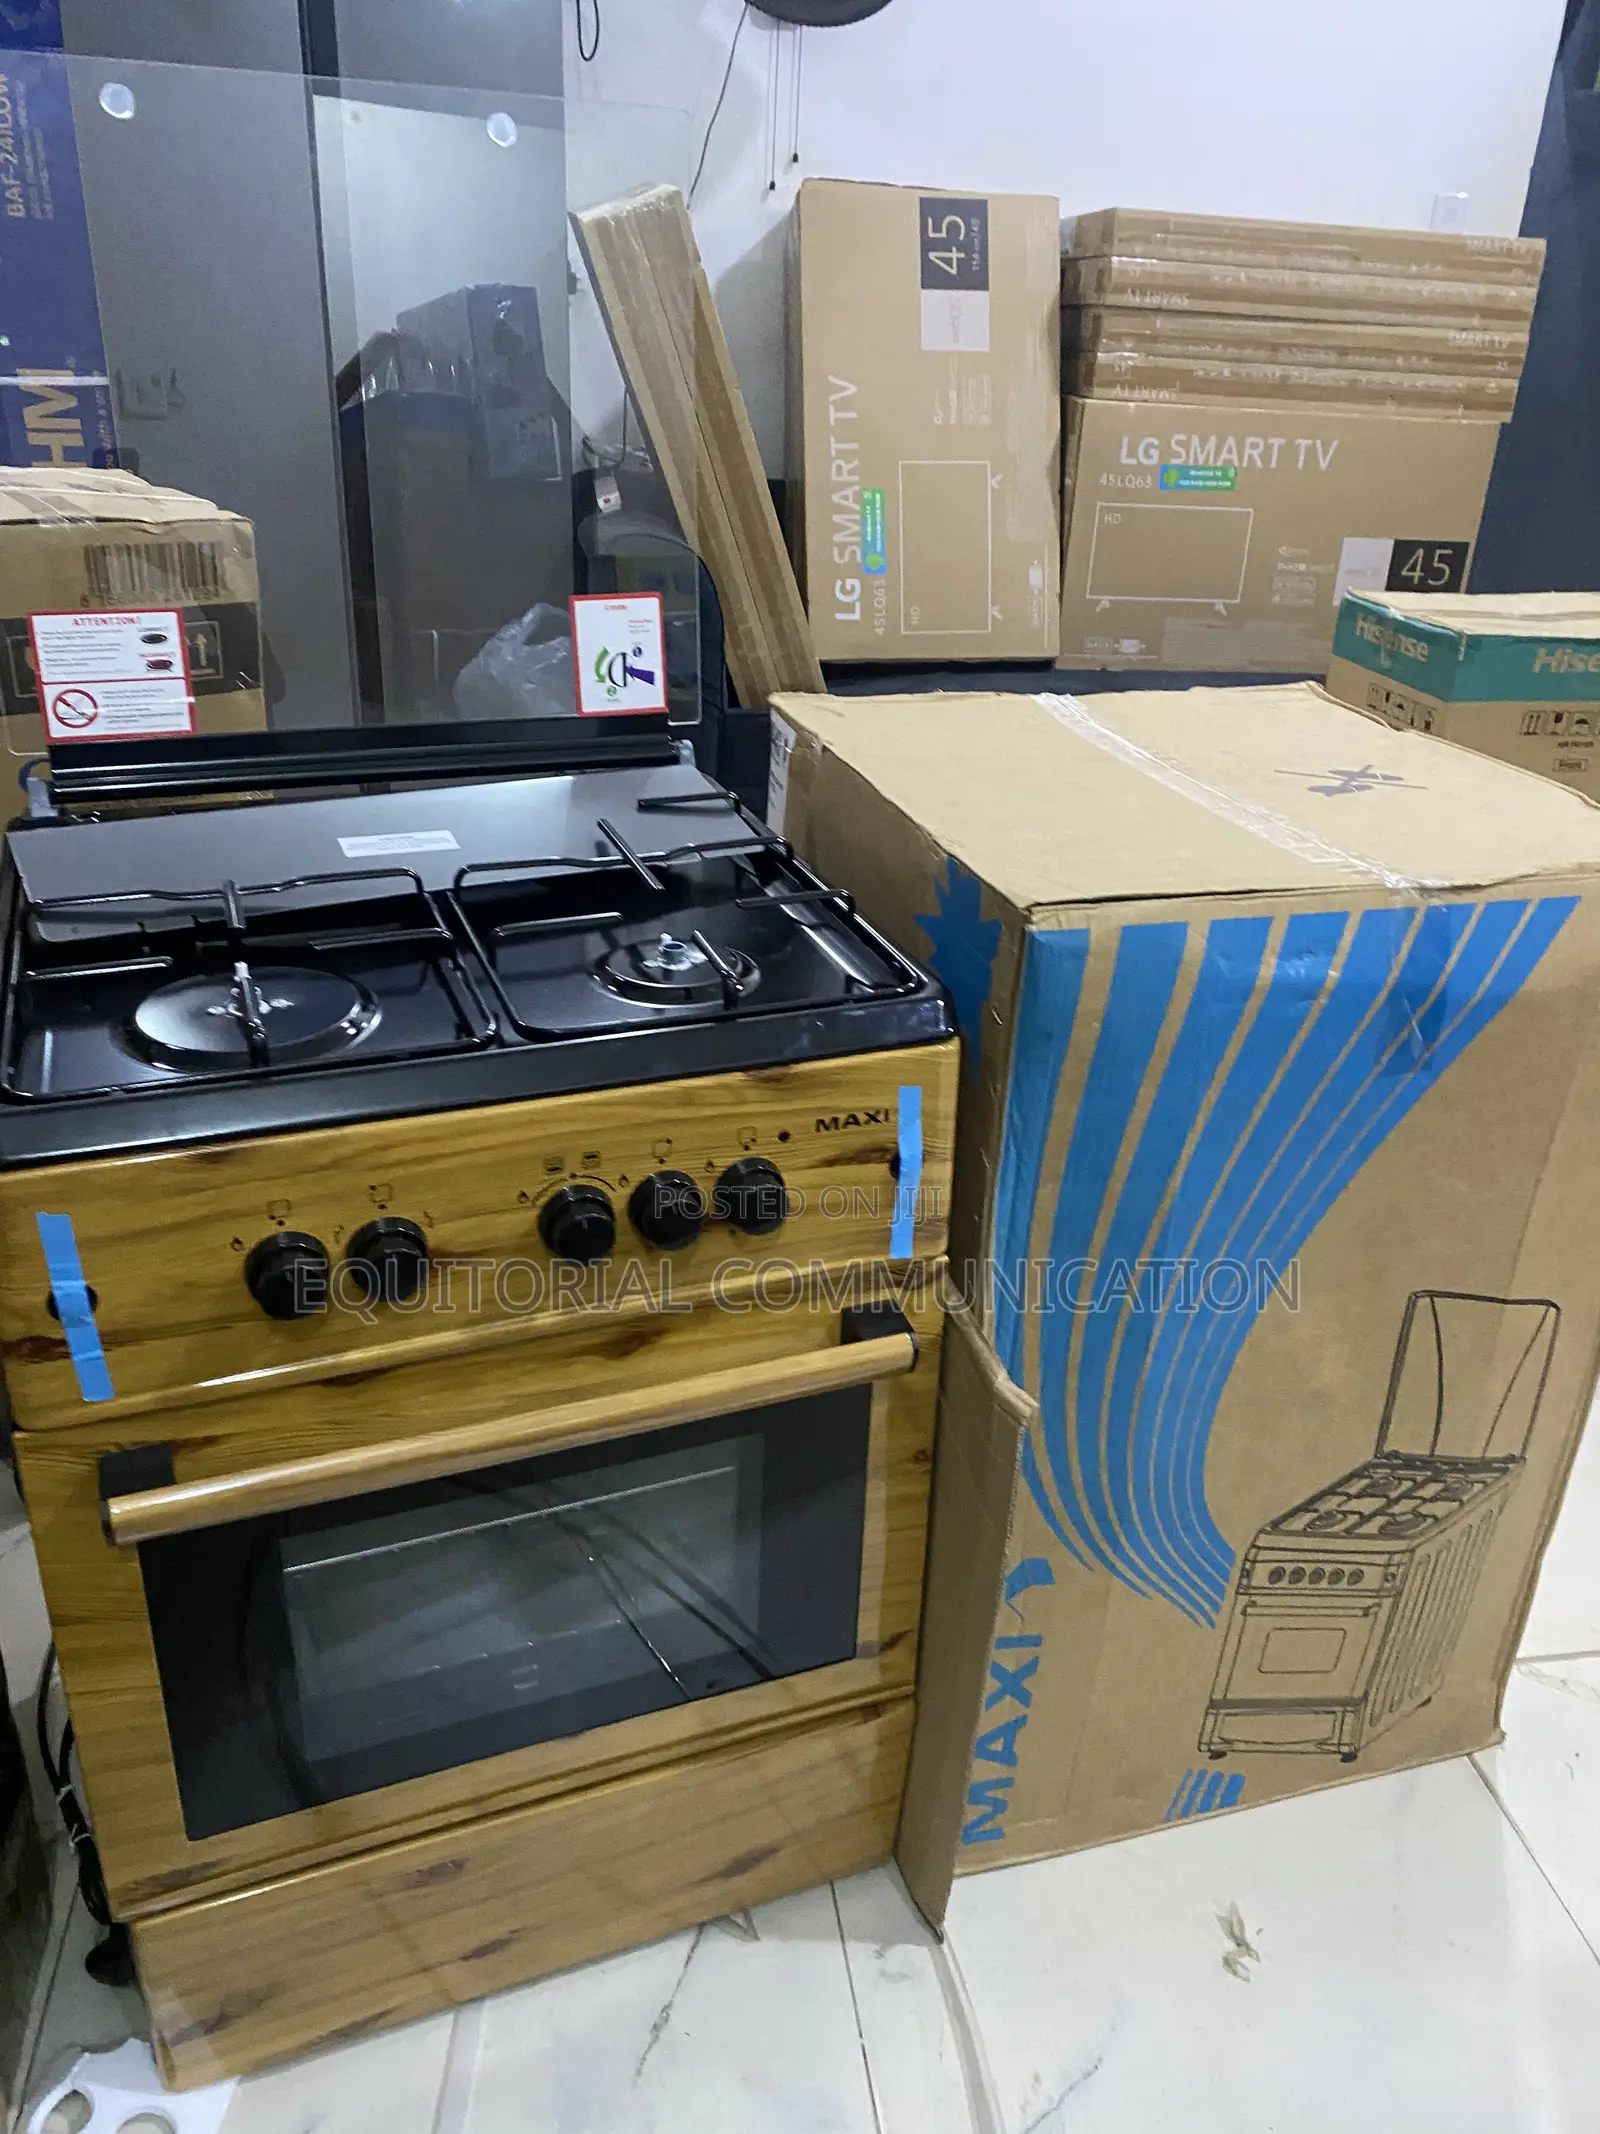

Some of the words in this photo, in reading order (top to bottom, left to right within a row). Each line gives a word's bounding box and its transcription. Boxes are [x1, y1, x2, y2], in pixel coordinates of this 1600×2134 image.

[928, 215, 965, 275] 45
[828, 374, 858, 427] TV
[1120, 435, 1160, 465] LG
[1169, 434, 1287, 468] SMART
[1294, 438, 1339, 471] TV
[829, 435, 861, 564] SMART
[1100, 471, 1152, 489] 45LQ63
[1400, 547, 1454, 586] 45
[834, 578, 861, 621] LG
[814, 1107, 890, 1134] MAXI
[961, 1634, 1044, 1845] MAXI
